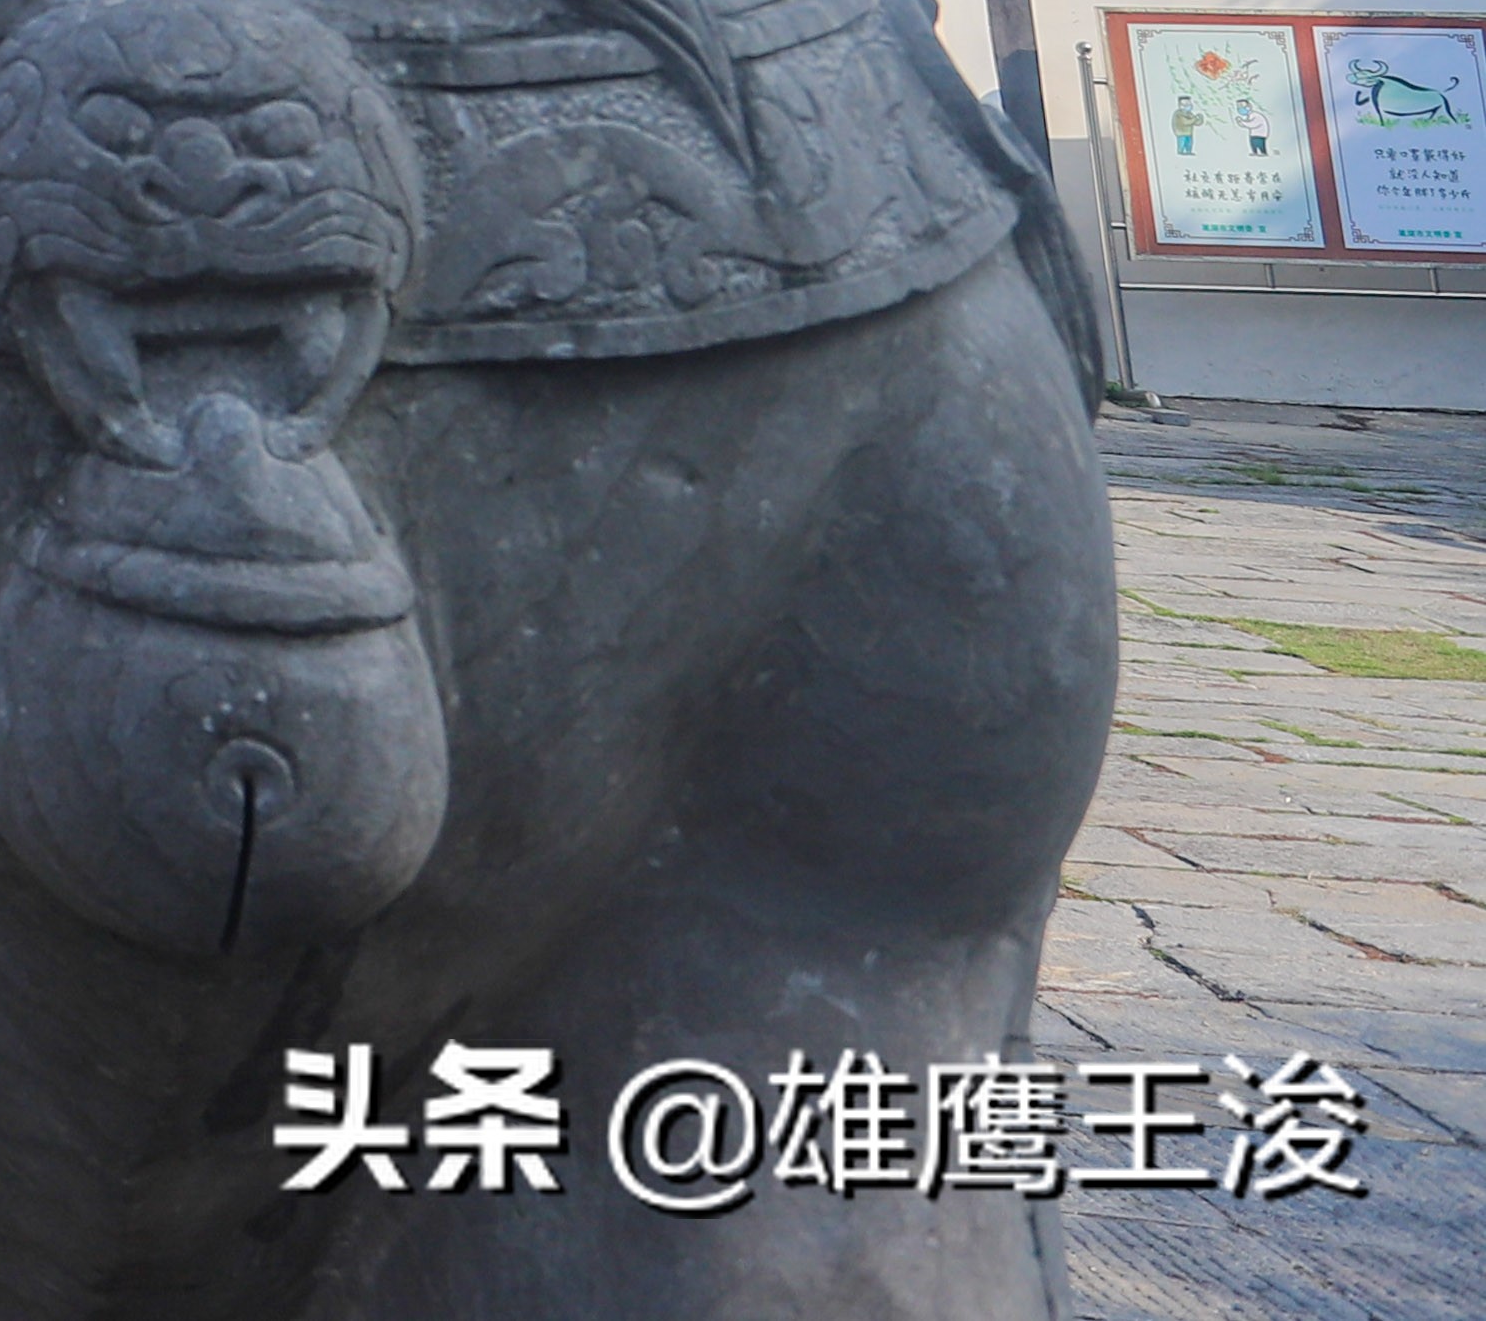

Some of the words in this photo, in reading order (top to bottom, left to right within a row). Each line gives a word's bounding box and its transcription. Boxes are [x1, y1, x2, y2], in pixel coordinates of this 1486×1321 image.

[1389, 168, 1461, 182] 就没人知道
